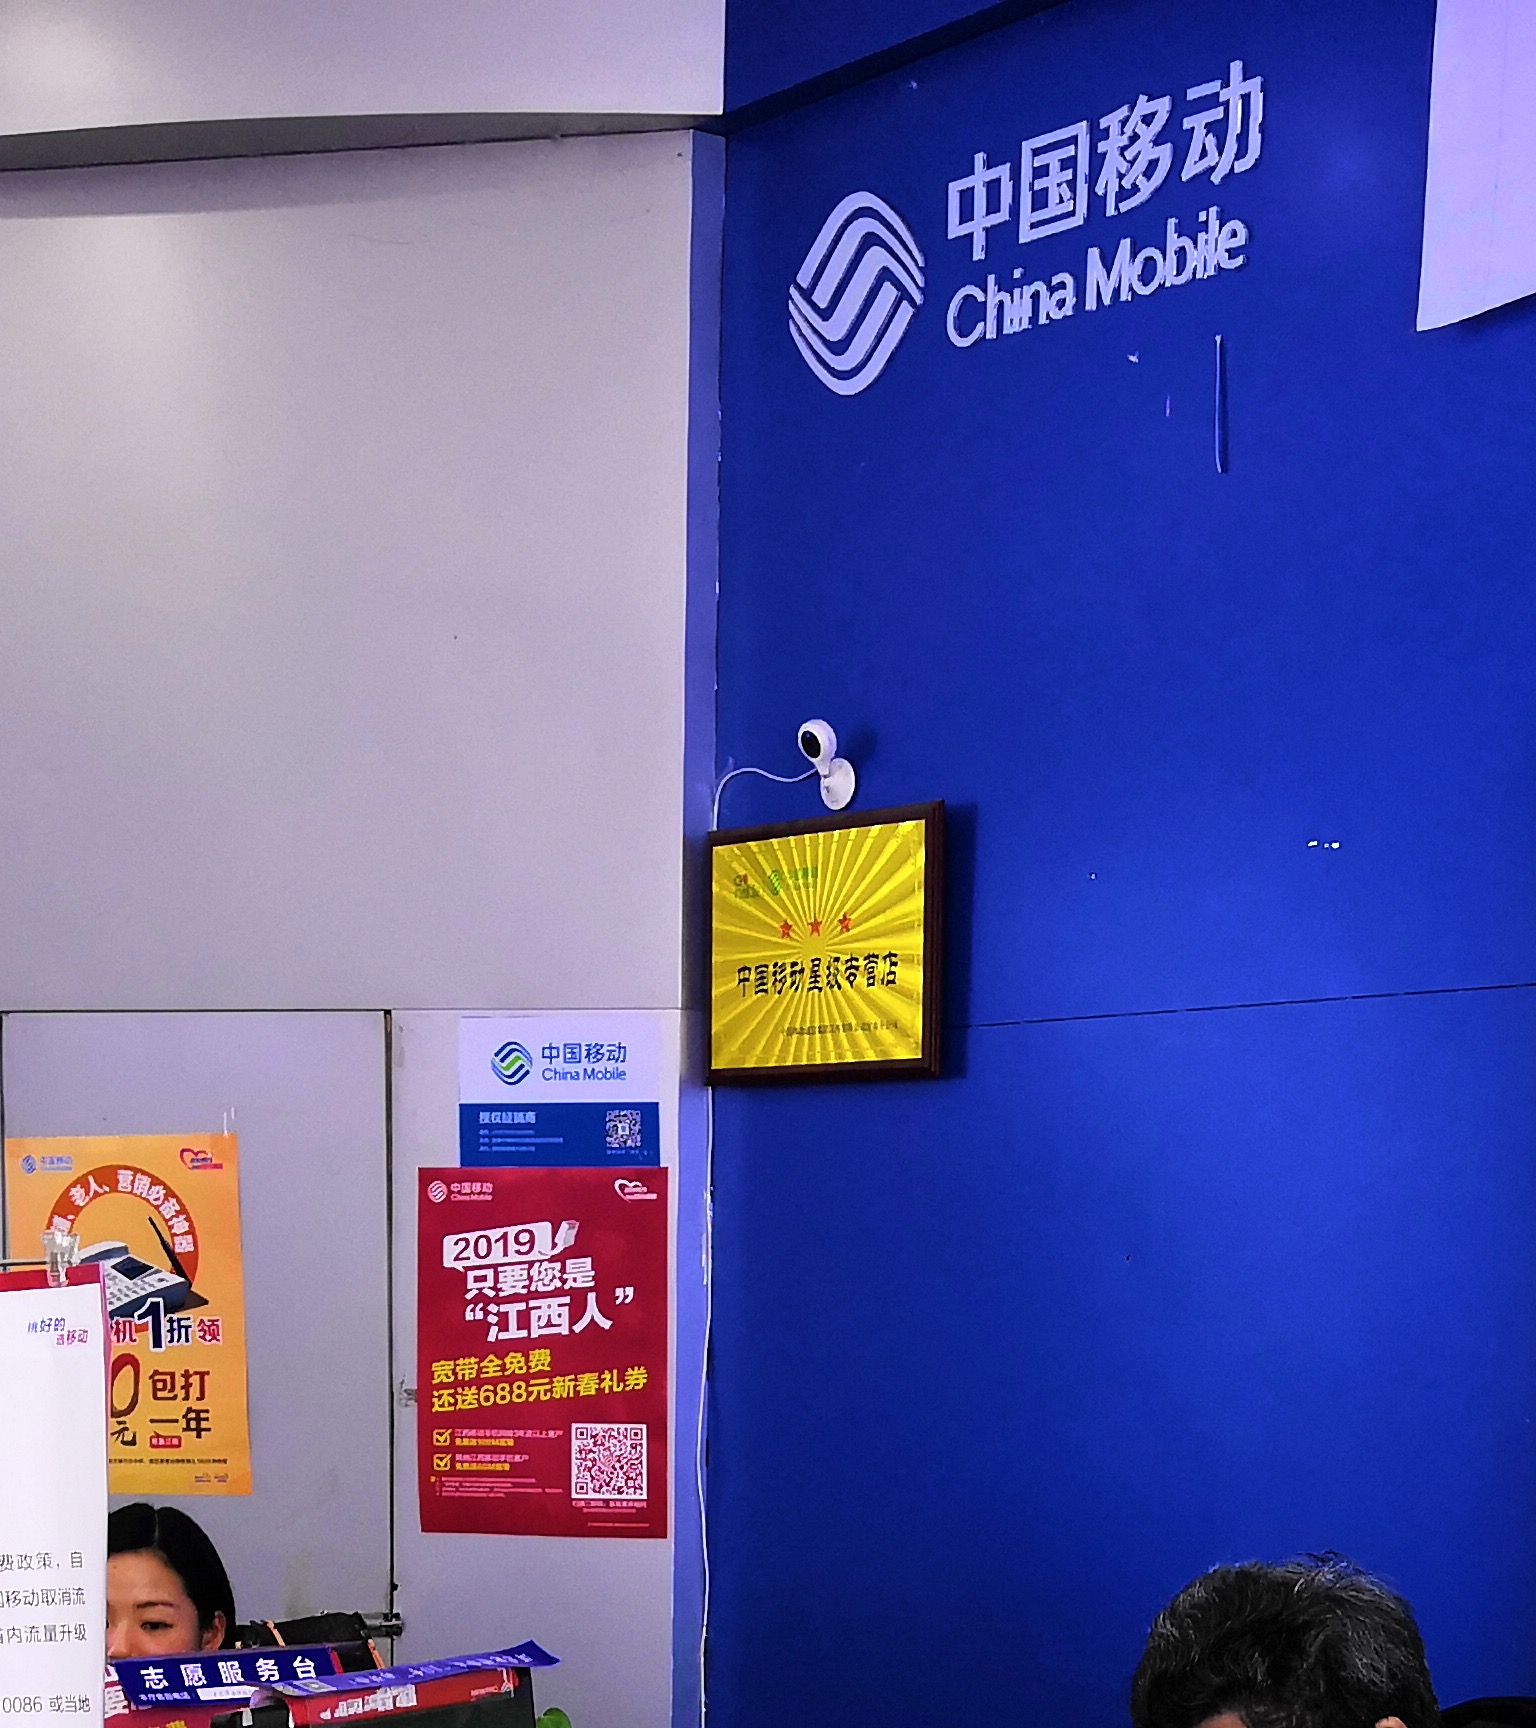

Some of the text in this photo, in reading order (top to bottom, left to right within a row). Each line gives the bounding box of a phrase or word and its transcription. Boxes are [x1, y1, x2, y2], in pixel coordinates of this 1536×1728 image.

[947, 60, 1263, 262] 中国移动
[947, 206, 1247, 347] China Mobile
[541, 1041, 627, 1065] 中国移动
[541, 1066, 627, 1082] China Mobile
[453, 1229, 535, 1262] 2019
[464, 1257, 595, 1300] 只要您是
[110, 1297, 221, 1352] 机1折领
[431, 1348, 551, 1385] 宽带全免费
[149, 1370, 211, 1402] 包打
[431, 1367, 648, 1413] 还送688元新春礼券
[149, 1407, 211, 1439] 一年
[140, 1656, 316, 1690] 志愿服务台
